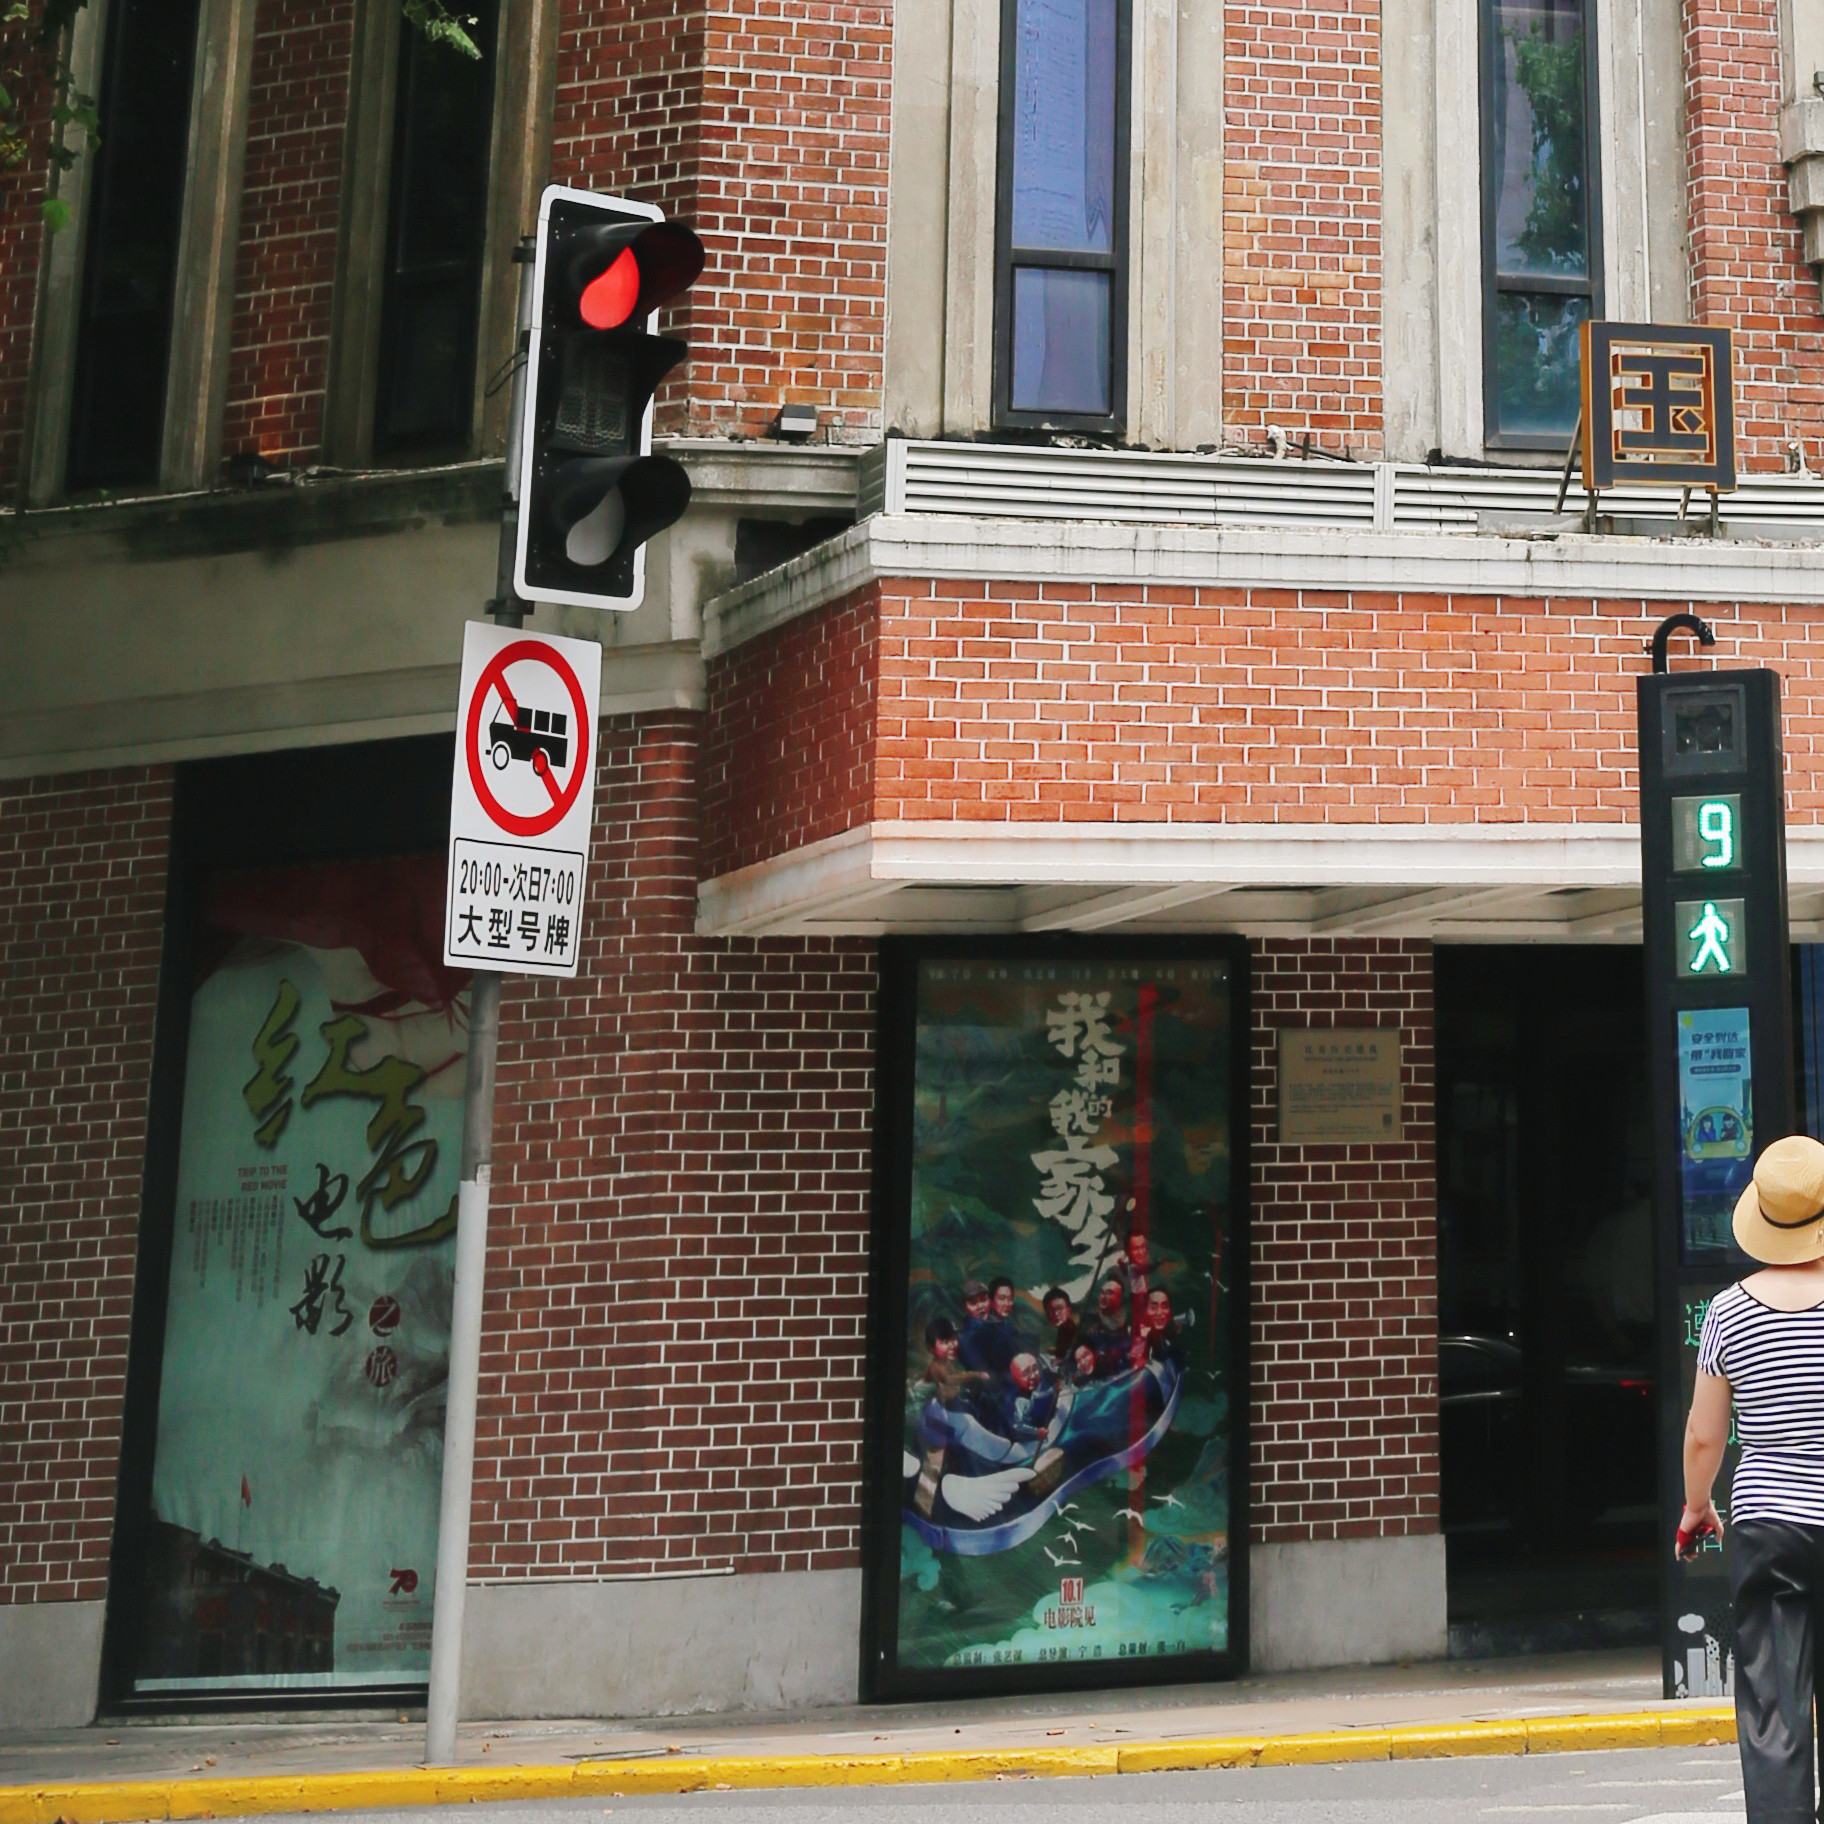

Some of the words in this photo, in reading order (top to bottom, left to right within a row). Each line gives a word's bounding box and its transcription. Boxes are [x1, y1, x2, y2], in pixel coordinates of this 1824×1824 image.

[1699, 800, 1734, 869] 9
[457, 904, 570, 956] 大型号牌
[1061, 1578, 1083, 1603] 10.1
[1044, 1606, 1097, 1629] 电影院见
